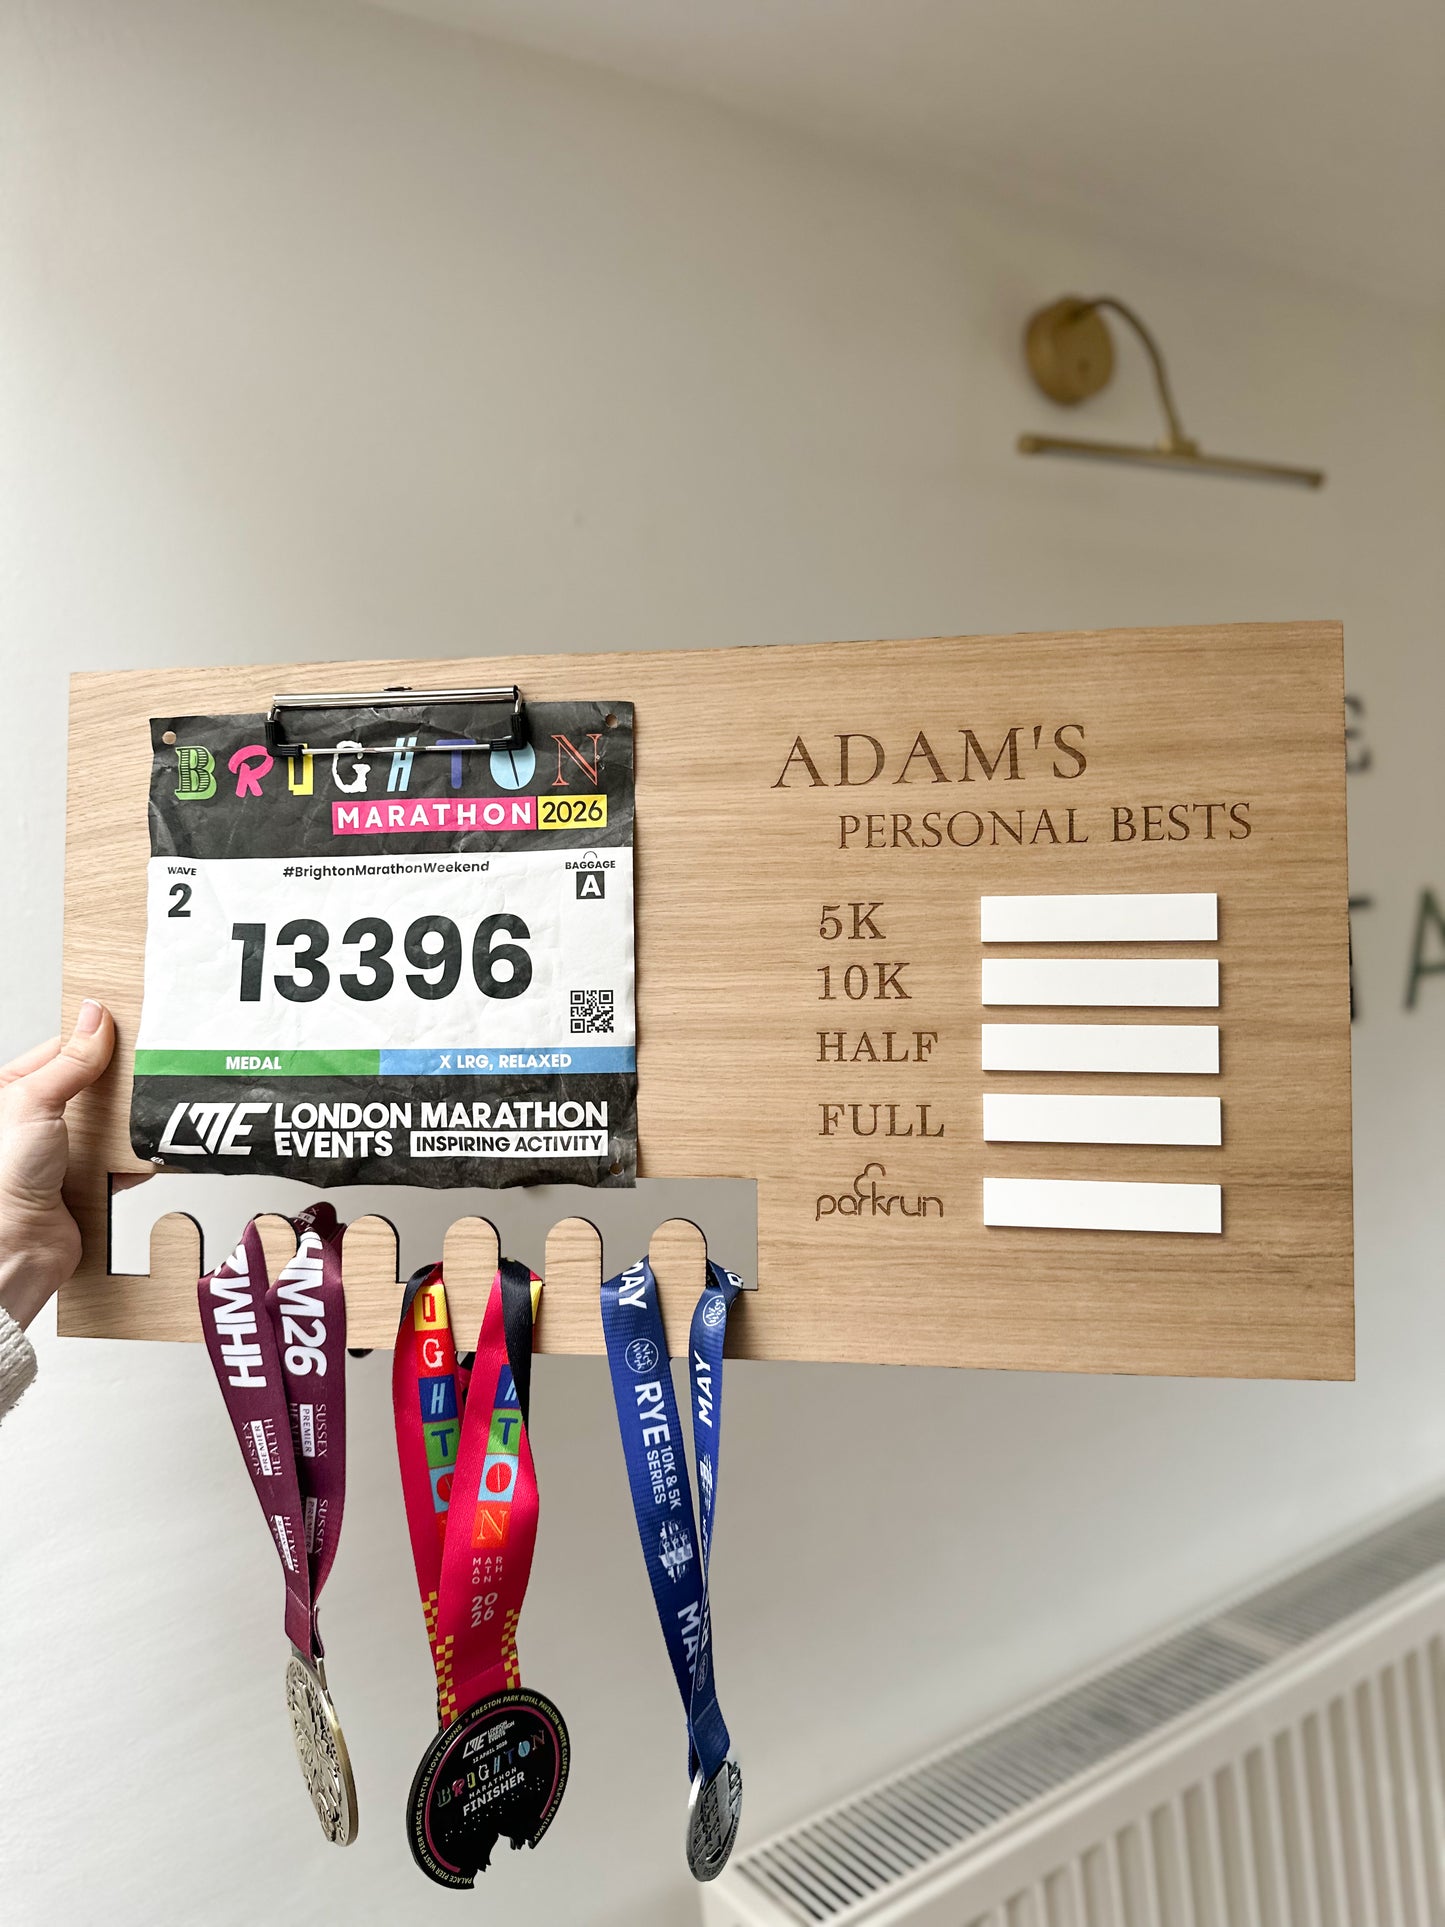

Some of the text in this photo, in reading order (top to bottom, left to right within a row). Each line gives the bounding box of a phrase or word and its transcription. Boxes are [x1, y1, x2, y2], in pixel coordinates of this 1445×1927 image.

[175, 733, 602, 800] BRIGHTON
[770, 724, 1088, 789] ADAM'S
[337, 800, 602, 830] MARATHON 2026
[838, 802, 1252, 850] PERSONAL BESTS
[167, 866, 197, 876] WAVE
[283, 861, 490, 878] #BrightonMarathonWeekend
[565, 860, 616, 870] BAGGAGE
[167, 883, 191, 918] 2
[580, 873, 602, 897] A
[818, 902, 886, 941] 5K
[231, 914, 533, 1003] 13396
[816, 962, 913, 1001] 10K
[225, 1055, 282, 1071] MEDAL
[439, 1053, 573, 1072] X LRG, RELAXED
[816, 1031, 939, 1063] HALF
[275, 1100, 609, 1129] LONDON MARATHON
[818, 1104, 945, 1138] FULL
[276, 1131, 393, 1158] EVENTS
[416, 1135, 603, 1153] INSPIRING ACTIVITY
[815, 1176, 944, 1221] parkrun
[277, 1231, 327, 1378] HM26
[643, 1343, 654, 1366] Nice
[694, 1350, 713, 1429] MAY
[302, 1408, 313, 1453] PREMIER
[315, 1403, 328, 1458] SUSSEX
[634, 1380, 671, 1448] RYE
[263, 1418, 283, 1476] HEALTH
[646, 1449, 667, 1505] SERIES
[660, 1445, 676, 1474] 10K
[668, 1488, 682, 1511] 5K
[470, 1607, 495, 1629] 26
[471, 1592, 498, 1612] 20
[471, 1697, 502, 1719] PRESTON
[427, 1751, 443, 1774] HOVE
[462, 1770, 525, 1817] FINISHER
[468, 1766, 517, 1800] MARATHON
